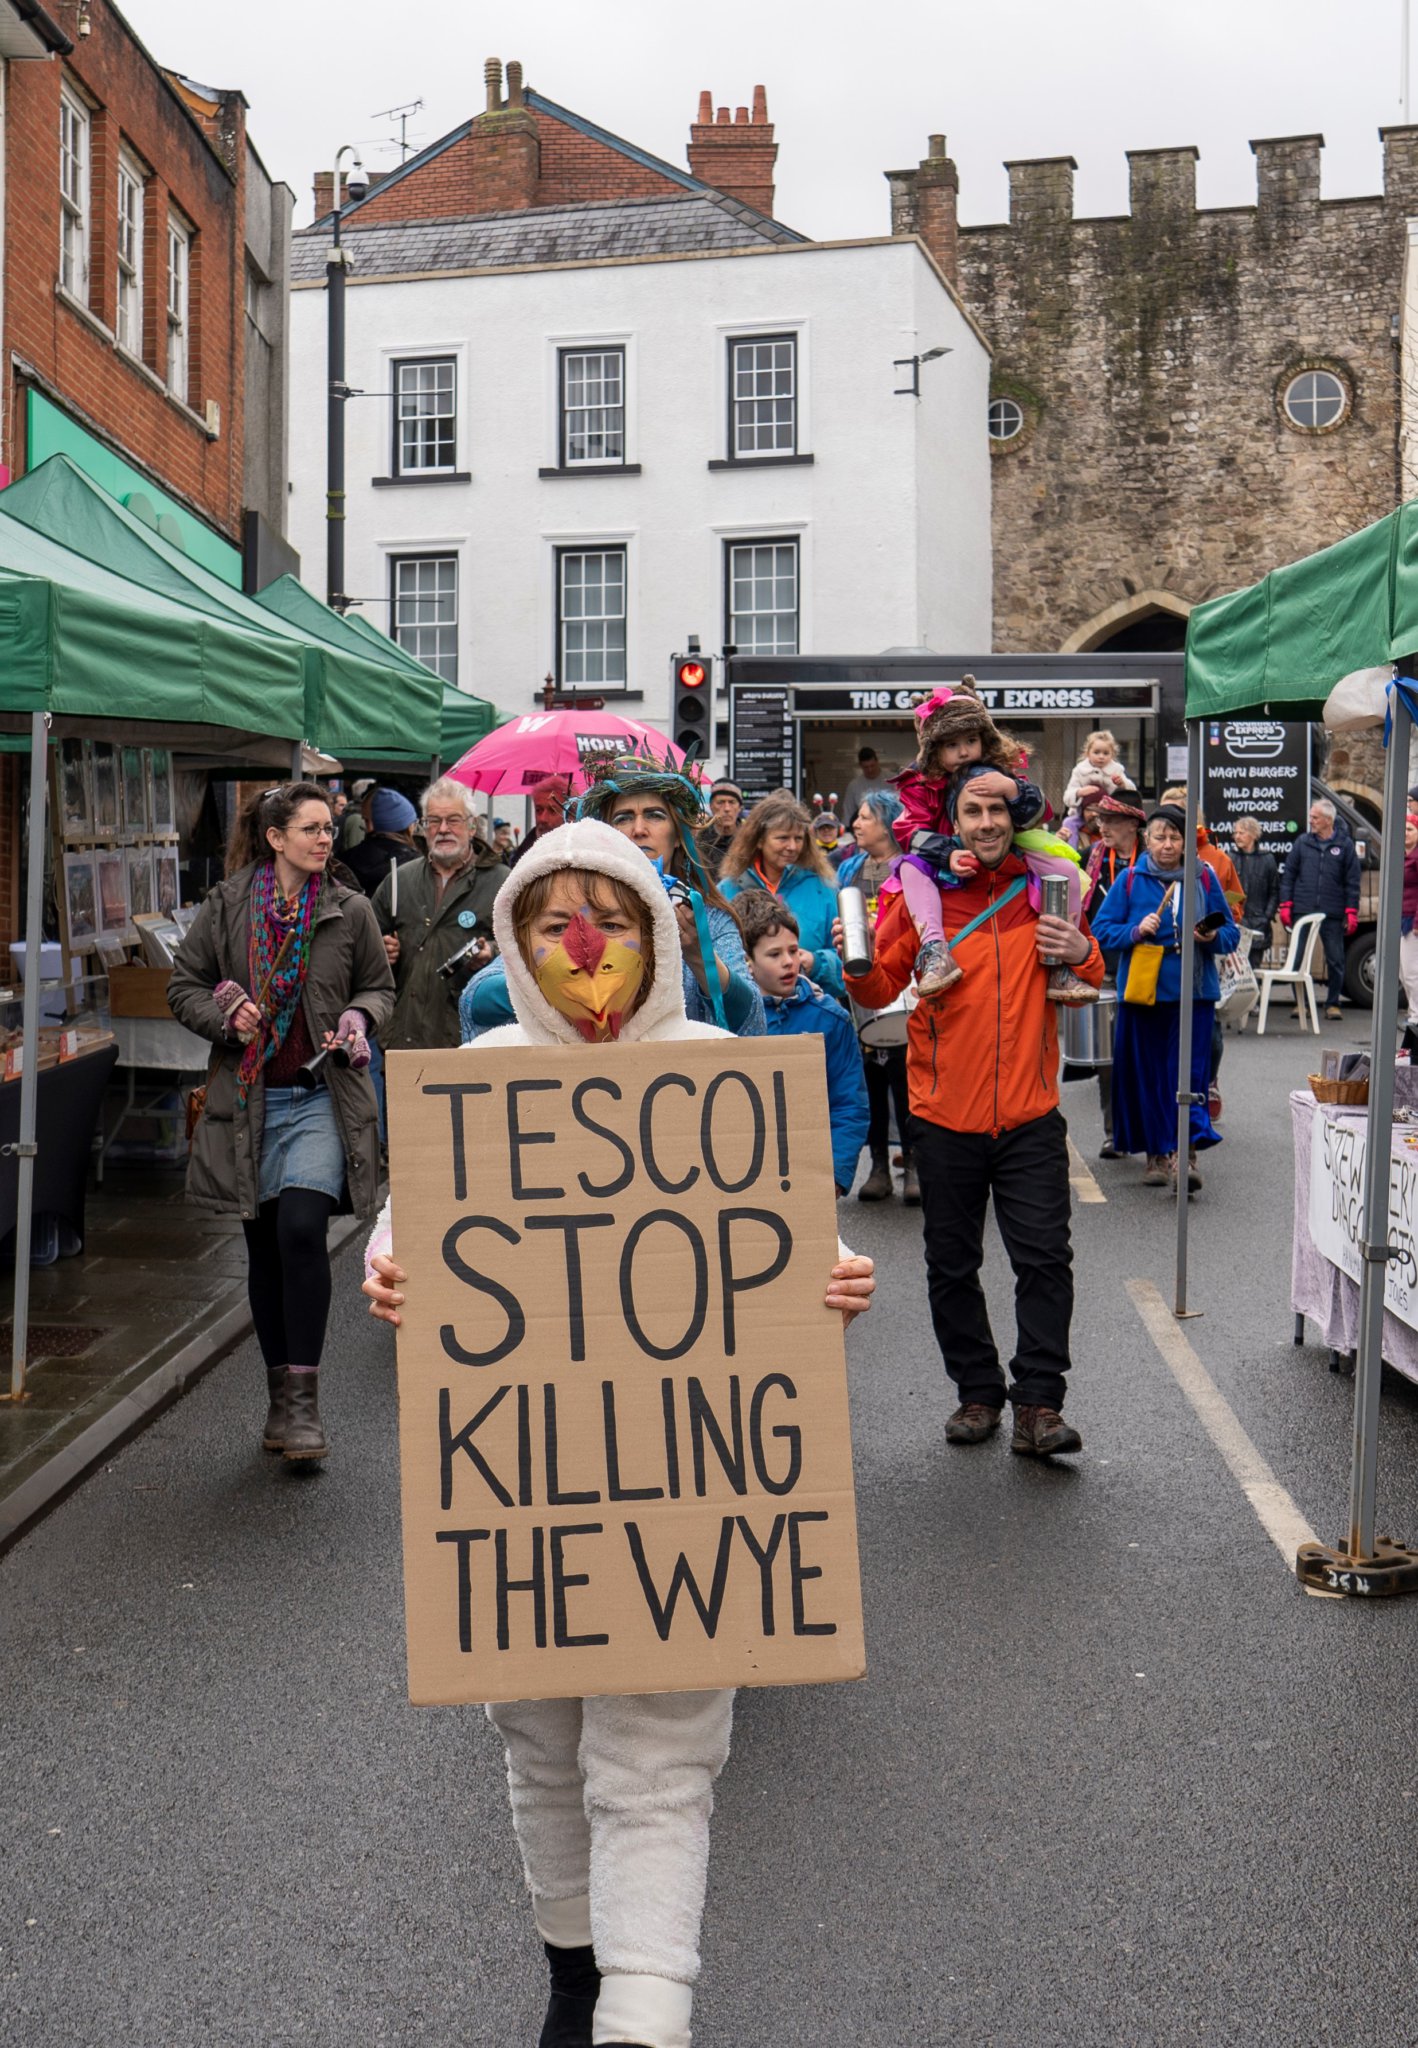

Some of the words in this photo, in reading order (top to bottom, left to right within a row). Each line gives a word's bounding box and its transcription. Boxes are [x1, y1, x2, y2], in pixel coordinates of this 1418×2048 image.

[576, 736, 628, 753] HOPE
[1208, 766, 1247, 778] WAGYU
[1248, 766, 1298, 778] BURGERS
[1222, 787, 1250, 799] WILD
[1252, 787, 1284, 799] BOAR
[1227, 800, 1280, 812] HOTDOGS
[1209, 821, 1237, 833] LOA
[422, 1069, 792, 1201] TESCO!
[439, 1207, 794, 1367] STOP
[437, 1372, 802, 1510] KILLING
[435, 1522, 610, 1653] THE
[624, 1511, 838, 1642] WYE
